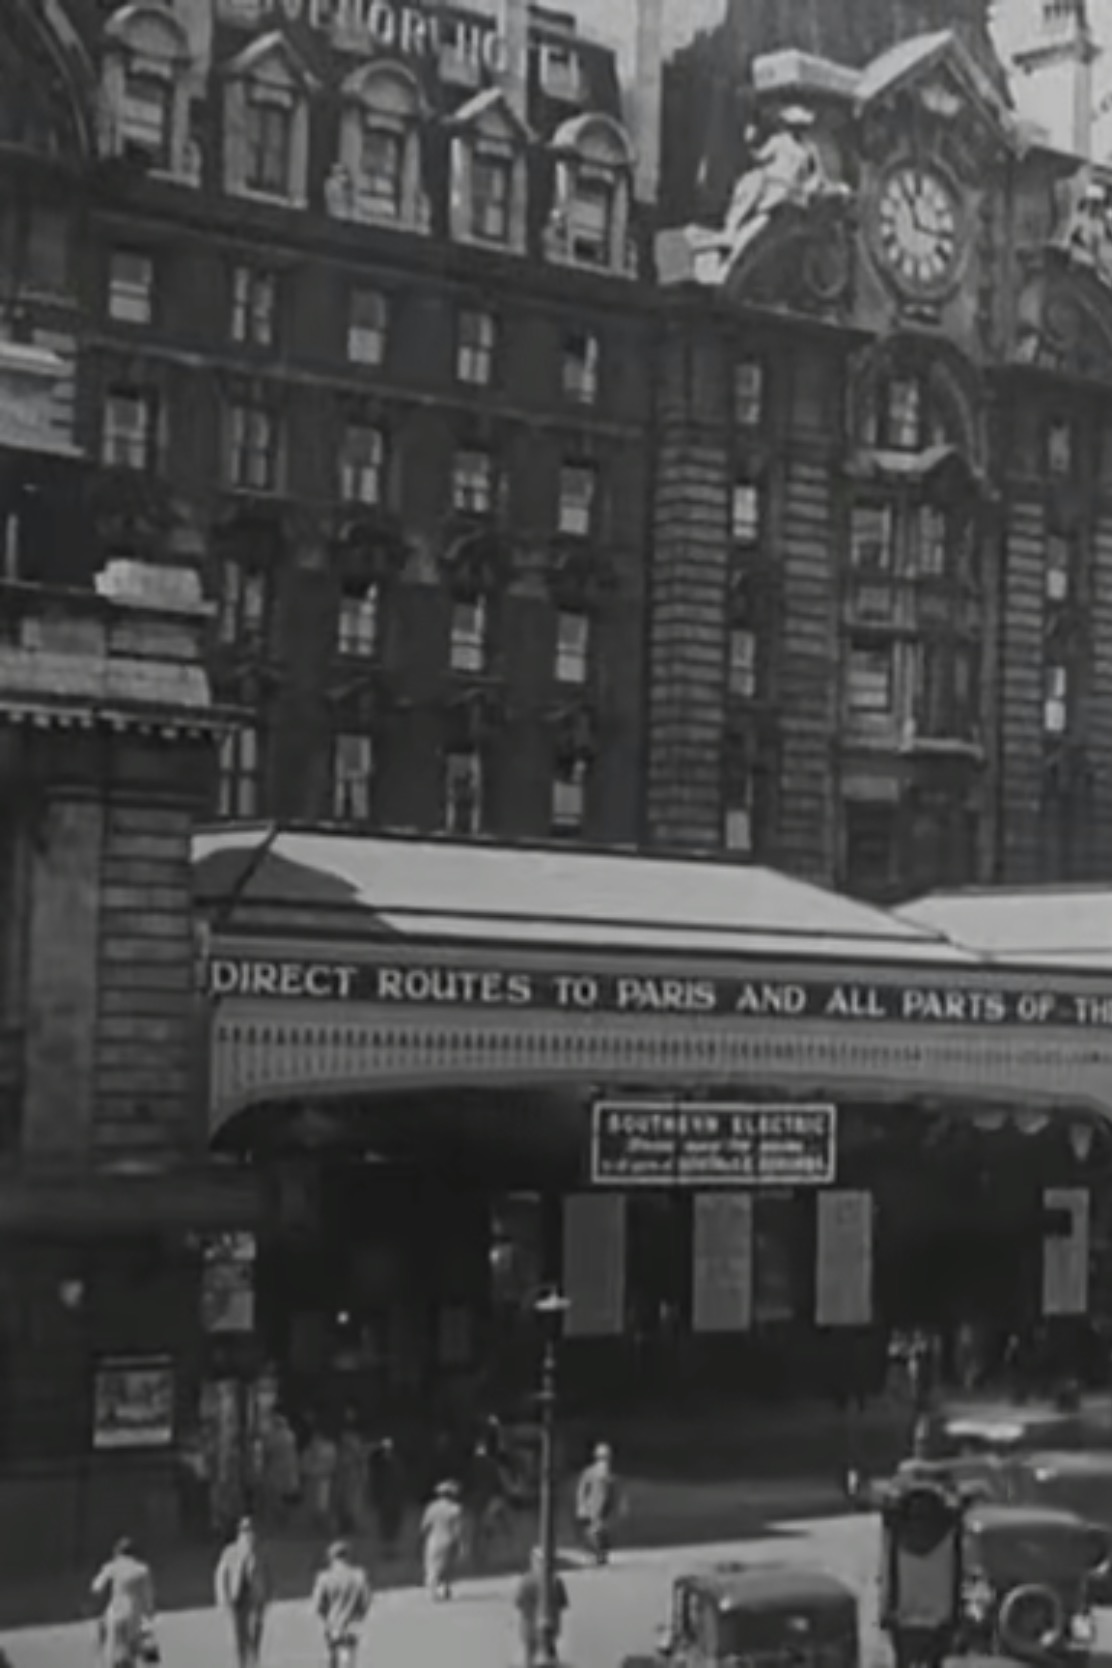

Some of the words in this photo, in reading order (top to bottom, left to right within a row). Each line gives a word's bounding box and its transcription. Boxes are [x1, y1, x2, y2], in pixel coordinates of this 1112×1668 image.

[211, 960, 357, 997] DIRECT
[378, 969, 532, 1004] ROUTES
[553, 976, 598, 1006] TO
[617, 977, 717, 1010] PARIS
[737, 984, 806, 1014] AND
[826, 987, 885, 1017] ALL
[903, 990, 1005, 1021] PARTS
[1016, 994, 1054, 1022] OF
